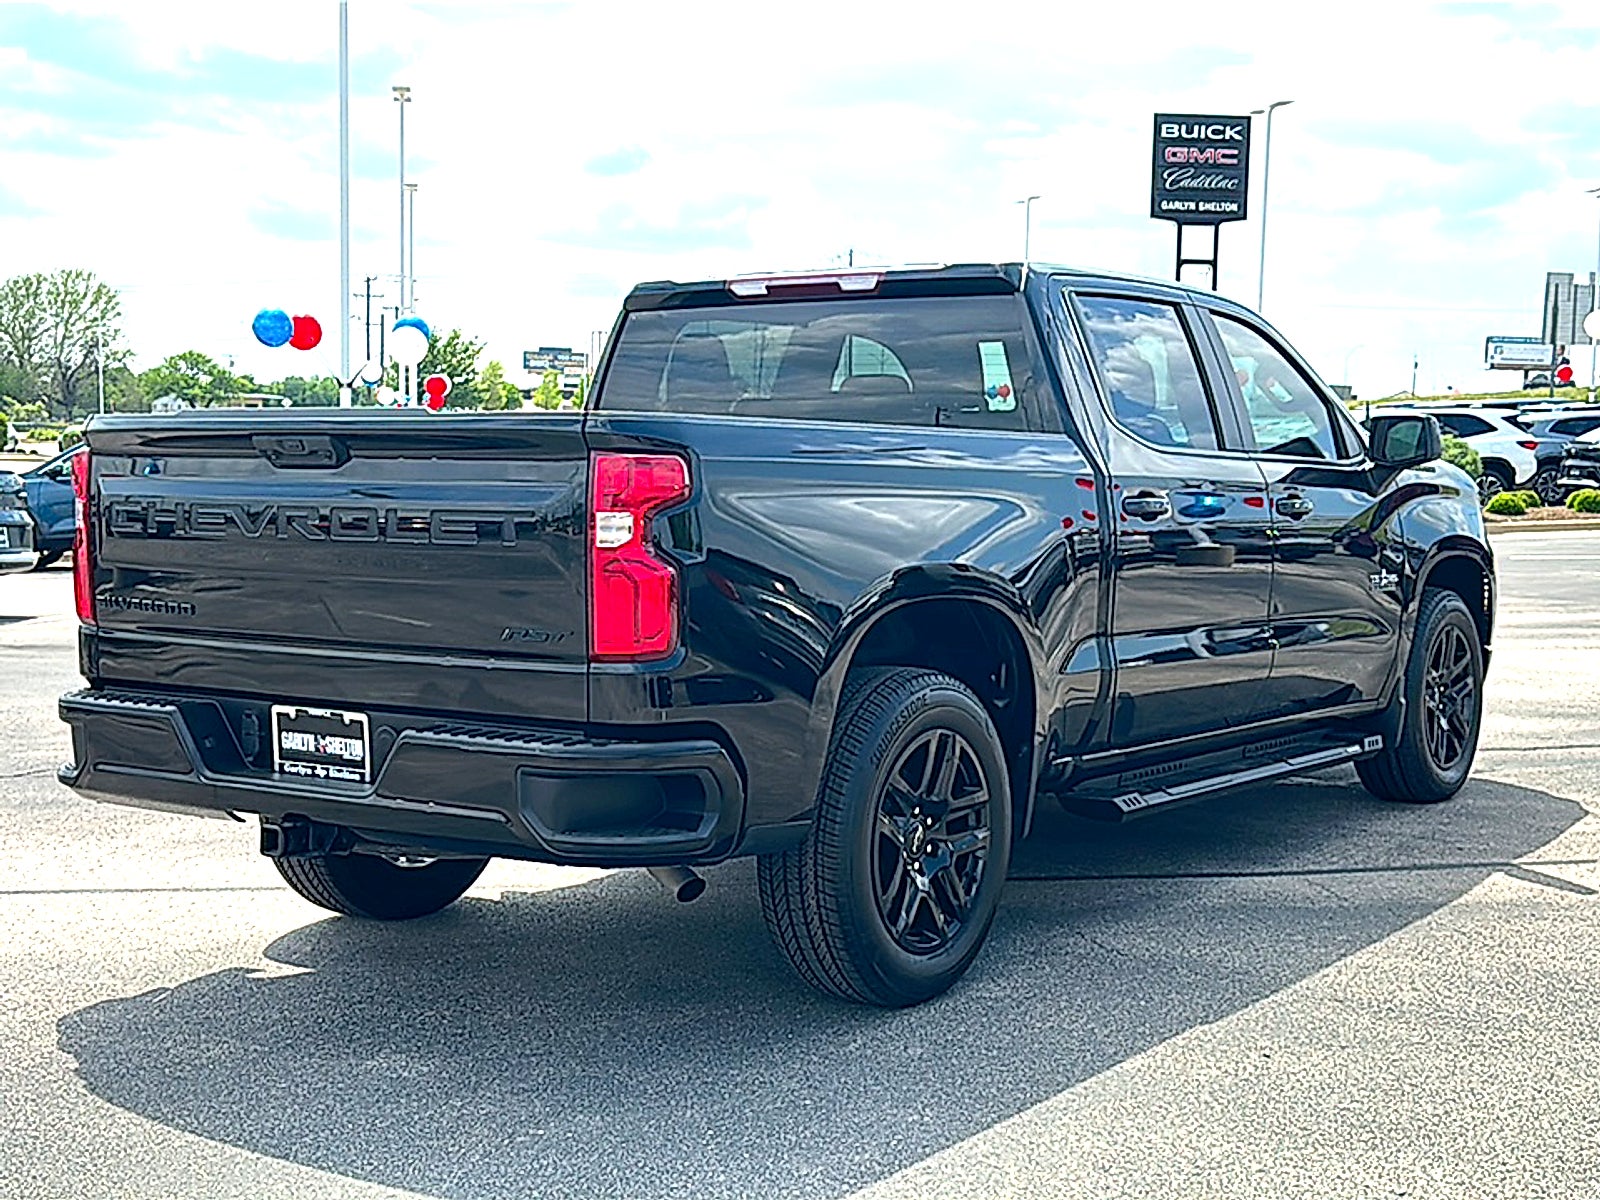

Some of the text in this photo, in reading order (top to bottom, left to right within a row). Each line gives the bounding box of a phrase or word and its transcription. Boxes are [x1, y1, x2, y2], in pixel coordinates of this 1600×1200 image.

[1160, 123, 1243, 140] BUICK
[1165, 147, 1239, 164] GMC
[1163, 167, 1239, 190] Cadillac
[1161, 200, 1238, 212] GARLYN SHELTON
[106, 500, 536, 547] CHEVROLET
